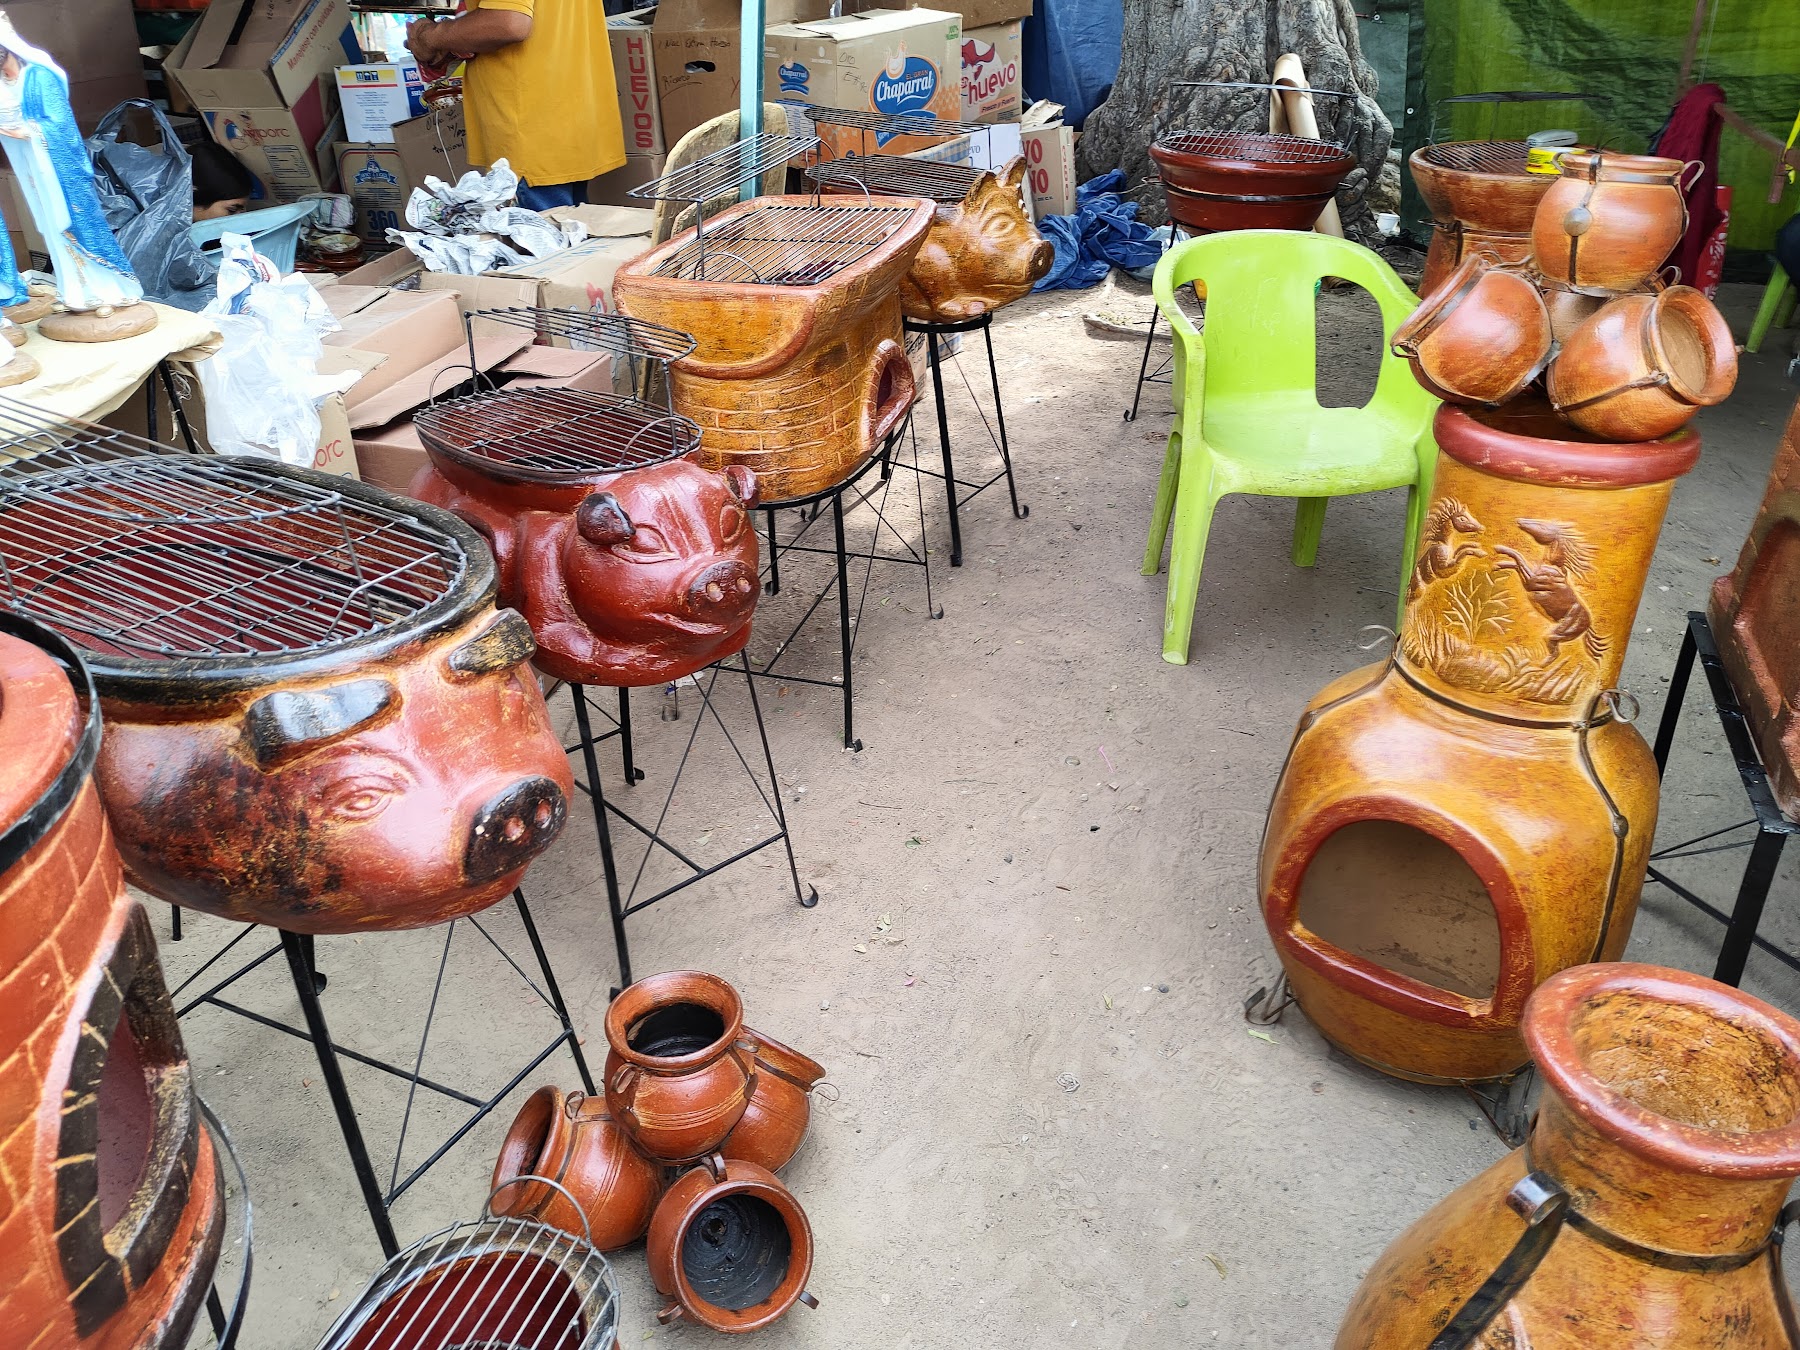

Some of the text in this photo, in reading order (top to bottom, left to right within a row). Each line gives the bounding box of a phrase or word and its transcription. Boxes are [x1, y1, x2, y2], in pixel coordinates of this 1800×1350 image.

[876, 70, 934, 103] Chaparral
[913, 69, 929, 79] GRAN
[967, 62, 1016, 106] huevo
[626, 37, 654, 149] HUEVOS
[367, 209, 399, 231] 360
